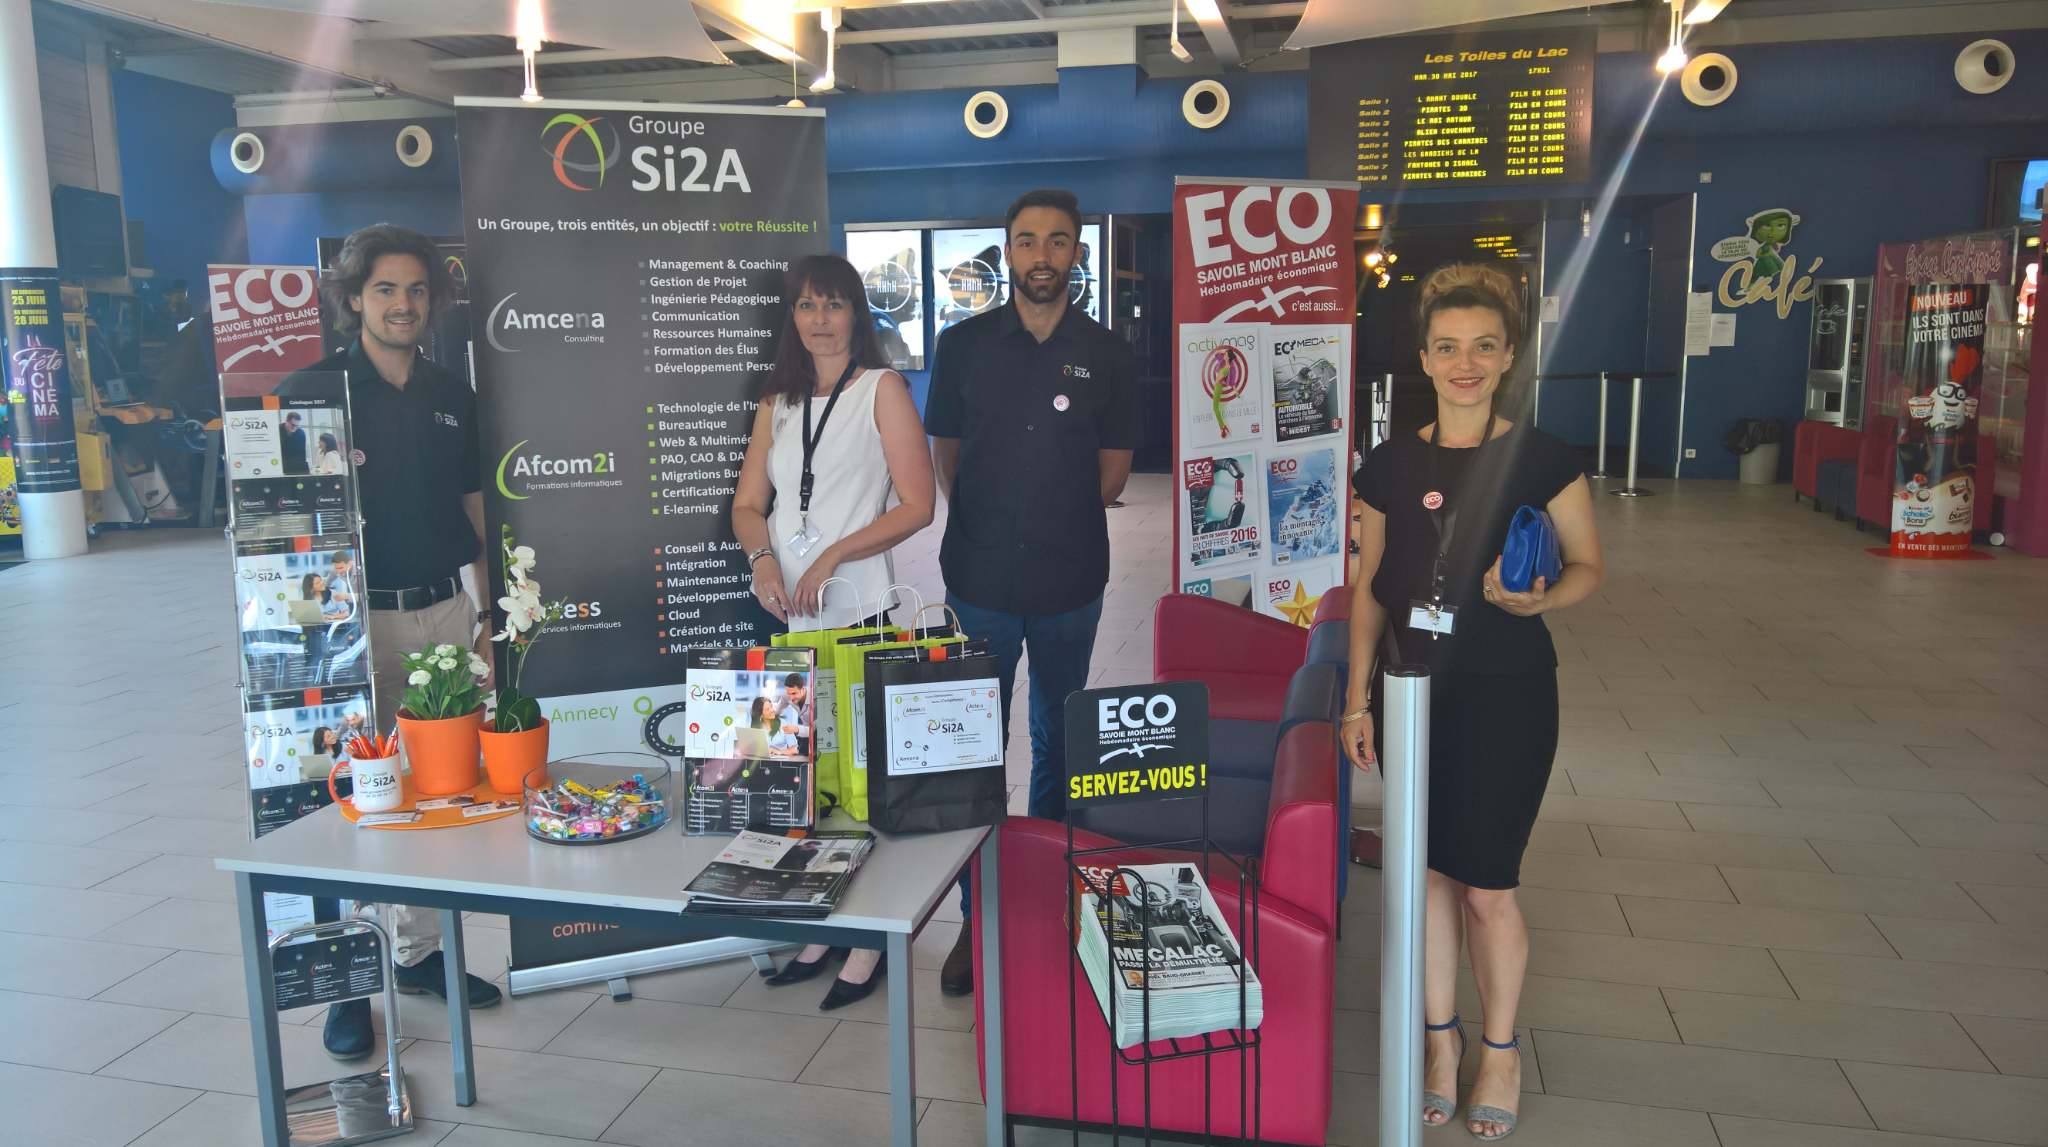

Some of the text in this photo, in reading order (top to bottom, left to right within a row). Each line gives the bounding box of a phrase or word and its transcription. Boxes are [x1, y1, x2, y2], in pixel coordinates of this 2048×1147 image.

[1424, 48, 1568, 63] Les Toiles du Lac
[628, 115, 705, 139] Groupe
[1404, 140, 1433, 148] PIRATES
[631, 145, 752, 193] Si2A
[477, 218, 497, 230] Un
[500, 218, 554, 233] Groupe,
[557, 219, 587, 231] trois
[590, 219, 639, 233] entités,
[642, 222, 658, 232] un
[661, 219, 710, 234] objectif
[719, 221, 753, 232] votre
[756, 219, 809, 233] Réussite
[1185, 186, 1332, 267] ECO
[649, 258, 789, 273] Management & Coaching
[1197, 244, 1336, 285] SAVOIE MONT BLANC
[650, 276, 747, 289] Gestion de Projet
[1200, 260, 1338, 297] Hebdomadaire économique
[1718, 254, 1824, 319] Café
[12, 295, 46, 305] 25 JUIN
[208, 269, 313, 323] ECO
[651, 293, 780, 308] Ingénierie Pédagogique
[1917, 291, 1967, 308] NOUVEAU
[1292, 300, 1344, 312] c'est aussi...
[28, 315, 48, 325] JUIN
[213, 307, 319, 335] SAVOIE MONT BLANC
[503, 309, 605, 330] Amcena
[652, 310, 740, 322] Communication
[1912, 308, 1984, 329] ILS SONT DANS
[216, 318, 320, 344] Hebdomadaire économique
[653, 327, 772, 340] Ressources Humaines
[1913, 323, 1983, 343] VOTRE CINÉMA
[564, 335, 604, 343] Consulting
[654, 342, 759, 357] Formation des Élus
[655, 361, 775, 375] Développement Perso
[657, 402, 724, 414] Technologie
[726, 401, 740, 412] de
[244, 421, 268, 430] Si2A
[659, 419, 727, 432] Bureautique
[660, 436, 685, 448] Web
[688, 436, 698, 447] &
[513, 452, 615, 477] Afcom2i
[661, 451, 745, 466] PAO, CAO & DA
[1187, 461, 1212, 476] ECO
[1271, 459, 1297, 474] ECO
[661, 469, 719, 483] Migrations
[526, 479, 623, 491] Formations informatiques
[662, 485, 735, 499] Certifications
[663, 503, 718, 517] E-learning
[1231, 526, 1257, 544] 2016
[665, 542, 704, 555] Conseil
[708, 541, 717, 552] &
[666, 558, 726, 573] Intégration
[258, 571, 282, 582] Si2A
[667, 574, 738, 589] Maintenance
[1269, 579, 1290, 593] ECO
[667, 588, 750, 605] Développemen
[668, 608, 700, 621] Cloud
[539, 620, 622, 634] ervices informatiques
[669, 624, 716, 638] Création
[719, 622, 732, 634] de
[736, 636, 756, 649] Log
[706, 691, 731, 702] Si2A
[551, 705, 618, 724] Annecy
[1098, 694, 1177, 732] ECO
[267, 727, 292, 738] Si2A
[942, 722, 964, 734] Si2A
[1099, 726, 1176, 740] SAVOIE MONT BLANC
[1099, 737, 1140, 745] Hebdomadaire
[1070, 765, 1195, 799] SERVEZ-VOUS
[552, 921, 620, 938] com
[1113, 943, 1224, 962] MECALAC
